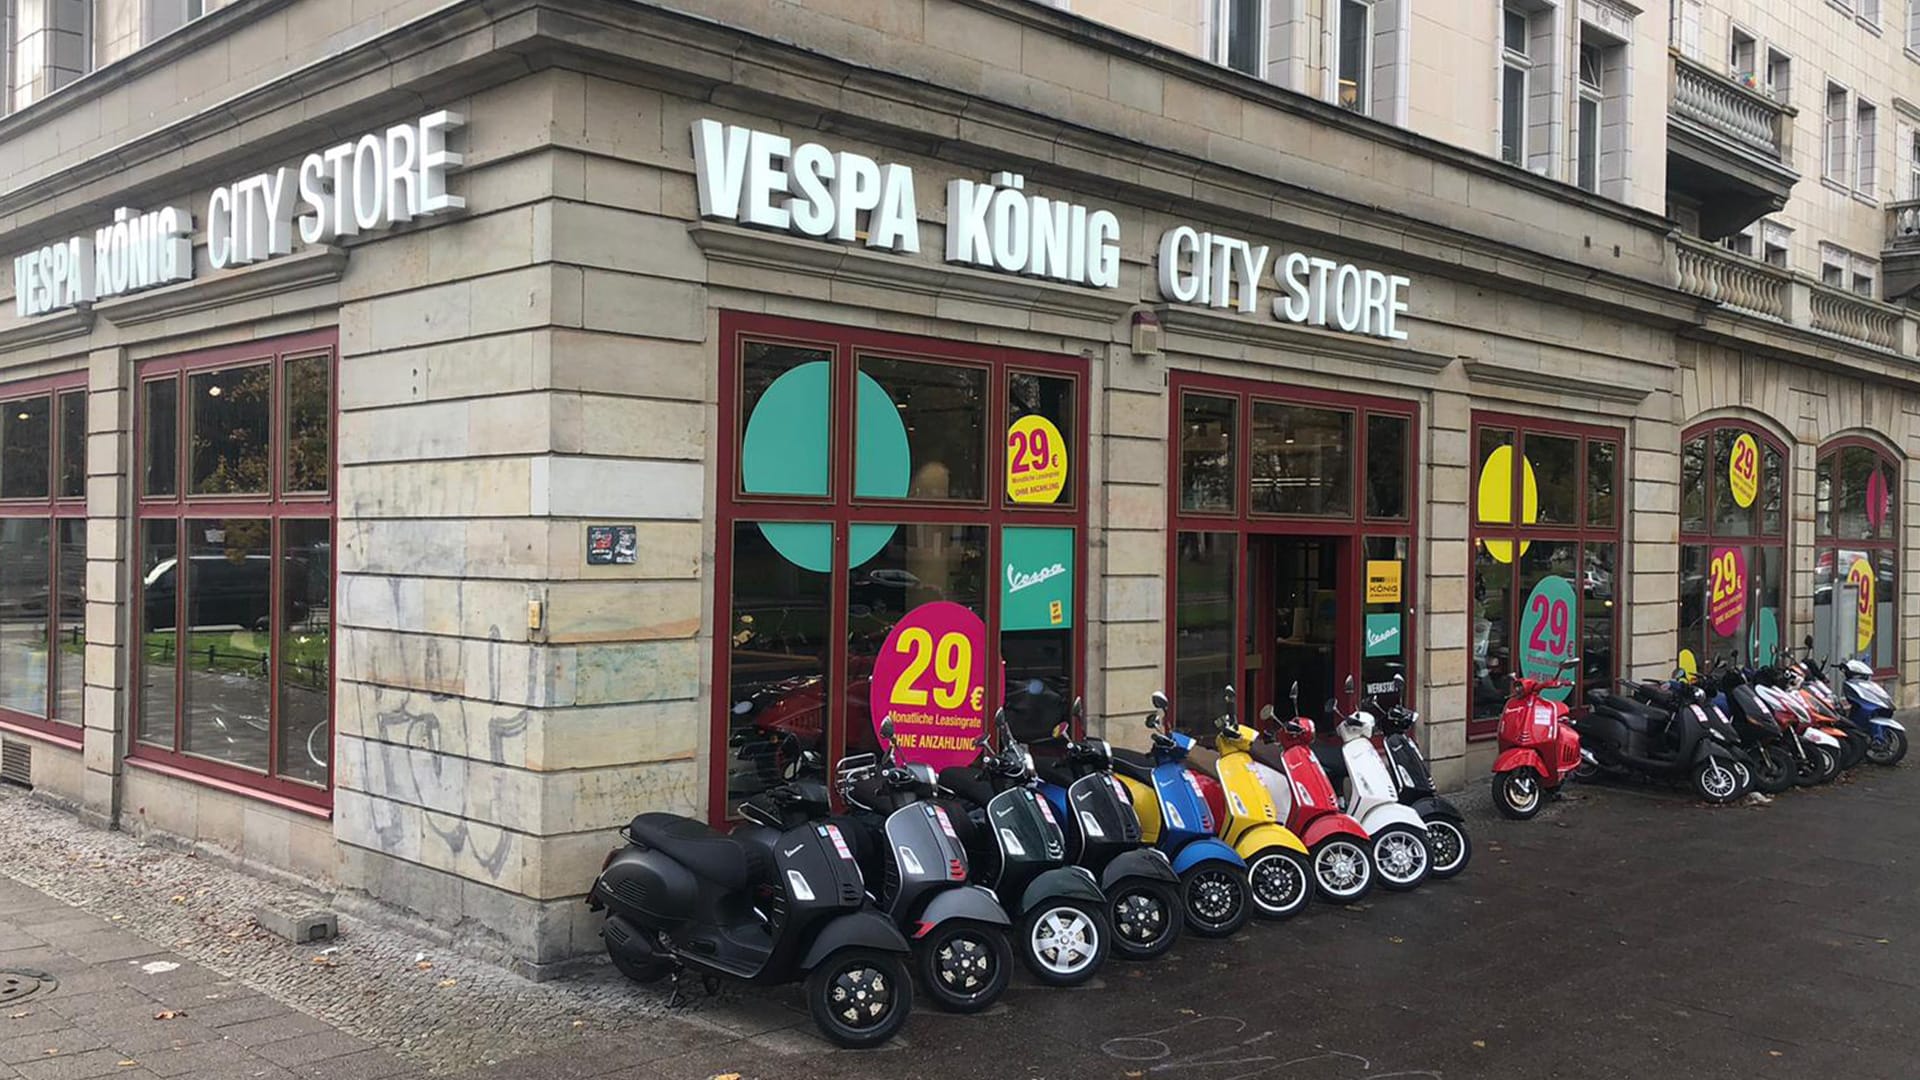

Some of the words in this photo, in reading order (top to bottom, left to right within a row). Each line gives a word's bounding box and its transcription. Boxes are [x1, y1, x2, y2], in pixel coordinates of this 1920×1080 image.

[208, 166, 299, 269] CITY
[299, 110, 465, 243] STORE
[692, 119, 919, 253] VESPA
[946, 171, 1121, 288] KÖNIG
[1158, 226, 1269, 313] CITY
[1274, 252, 1410, 340] STORE
[14, 236, 96, 318] VESPA
[95, 206, 192, 298] KÖNIG
[1007, 563, 1066, 593] Vespa
[1367, 626, 1399, 648] Vespa
[888, 710, 934, 725] Monatliche
[935, 714, 982, 730] Leasingrate
[894, 733, 917, 748] HNE
